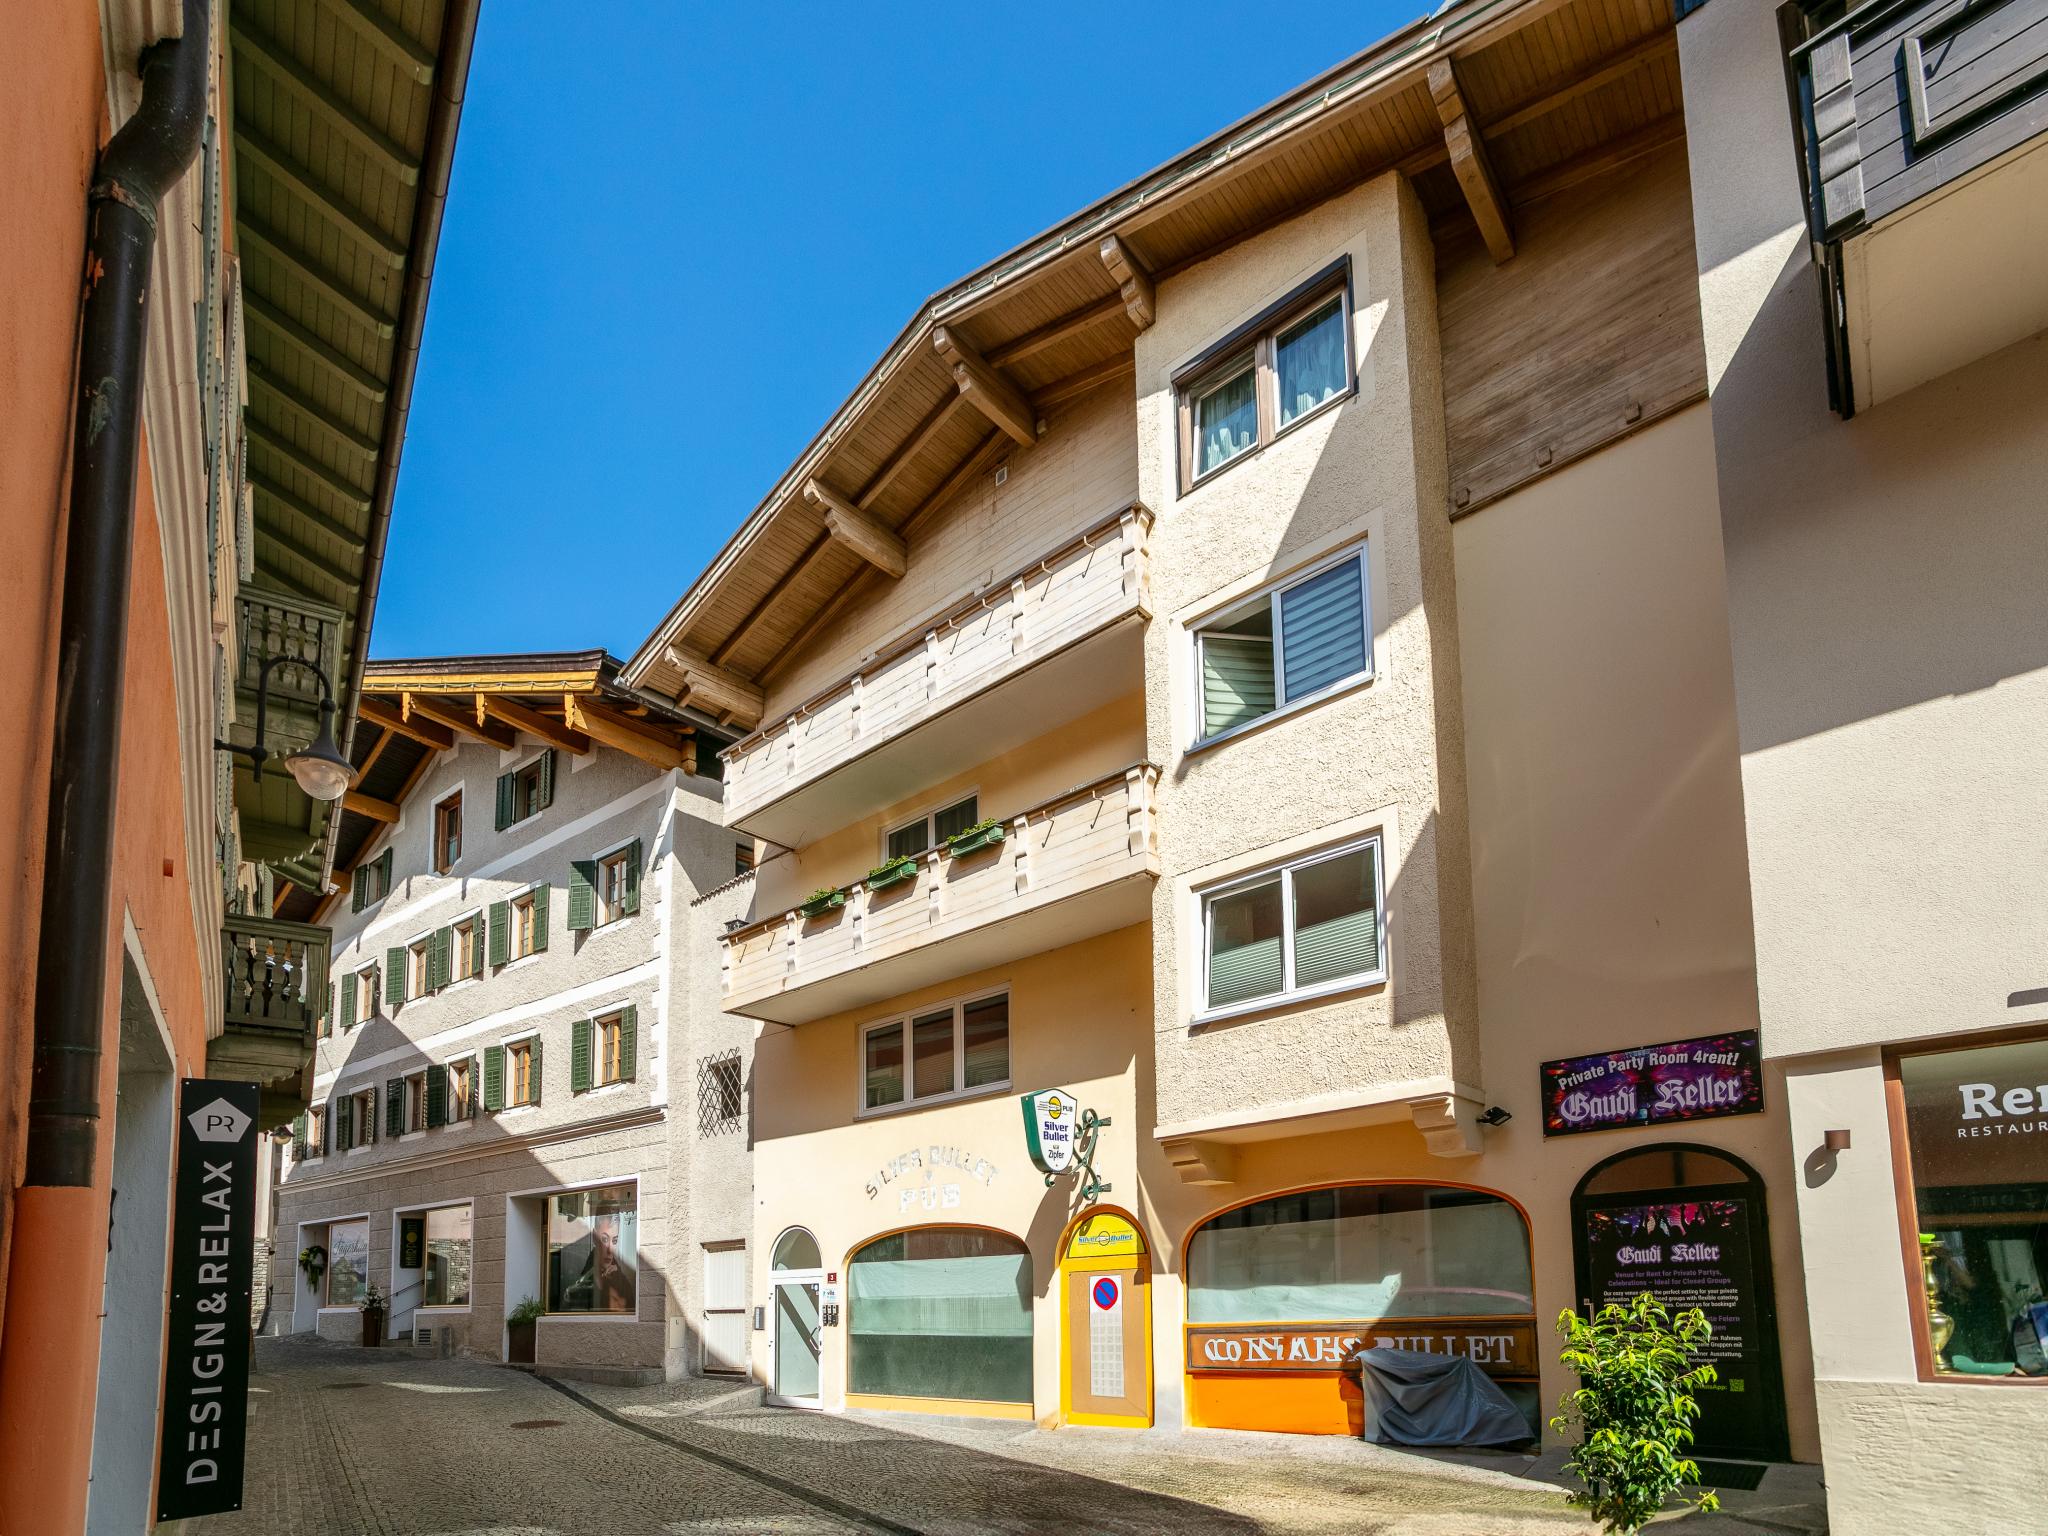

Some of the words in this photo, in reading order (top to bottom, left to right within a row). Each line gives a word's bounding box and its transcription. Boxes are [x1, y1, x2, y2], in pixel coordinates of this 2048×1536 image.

[1558, 1066, 1605, 1090] Private
[1608, 1056, 1645, 1073] Party
[1649, 1052, 1688, 1066] Room
[1692, 1050, 1740, 1066] 4rent!
[1560, 1086, 1636, 1122] Gaudi
[1654, 1074, 1741, 1111] Keller
[1043, 1131, 1069, 1142] Bullet
[1044, 1121, 1069, 1132] Silver
[1048, 1149, 1065, 1161] Zipfer
[898, 1183, 961, 1214] PUB
[1616, 1245, 1661, 1265] Gaudi
[1670, 1243, 1720, 1262] Keller
